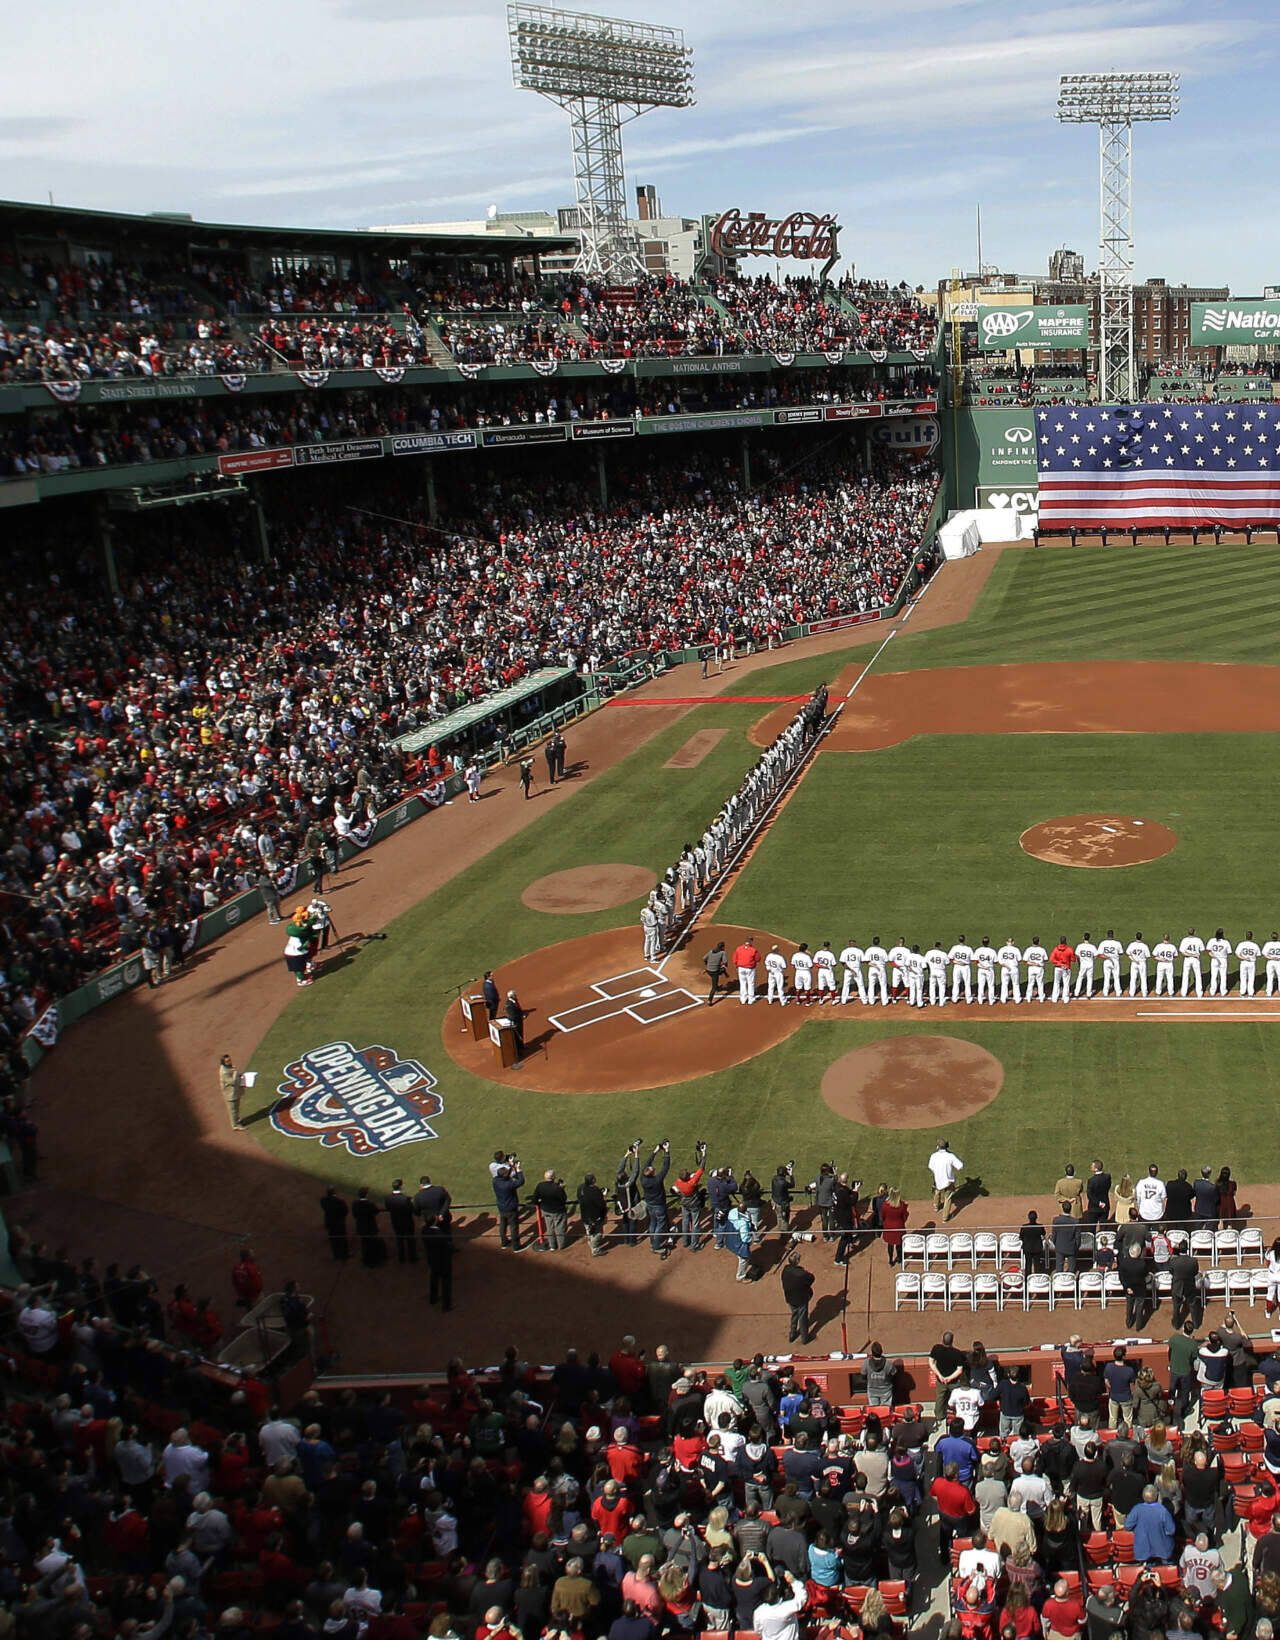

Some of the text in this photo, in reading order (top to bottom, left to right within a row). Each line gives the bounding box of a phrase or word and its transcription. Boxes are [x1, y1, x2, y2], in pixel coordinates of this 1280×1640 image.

[711, 208, 837, 259] Coca-Cola
[985, 312, 1016, 336] AAA
[1038, 318, 1085, 327] MAPFRE
[1254, 329, 1270, 338] Car
[673, 361, 740, 372] NATIONAL ANTHEM
[872, 424, 934, 443] Gulf
[394, 437, 444, 450] COLUMBIA
[446, 433, 474, 444] TECH
[1132, 948, 1143, 956] 47
[1187, 944, 1196, 952] 41
[846, 953, 857, 962] 13
[306, 1044, 395, 1116] OPENING
[362, 1105, 429, 1148] DAY
[1145, 1190, 1157, 1200] 17
